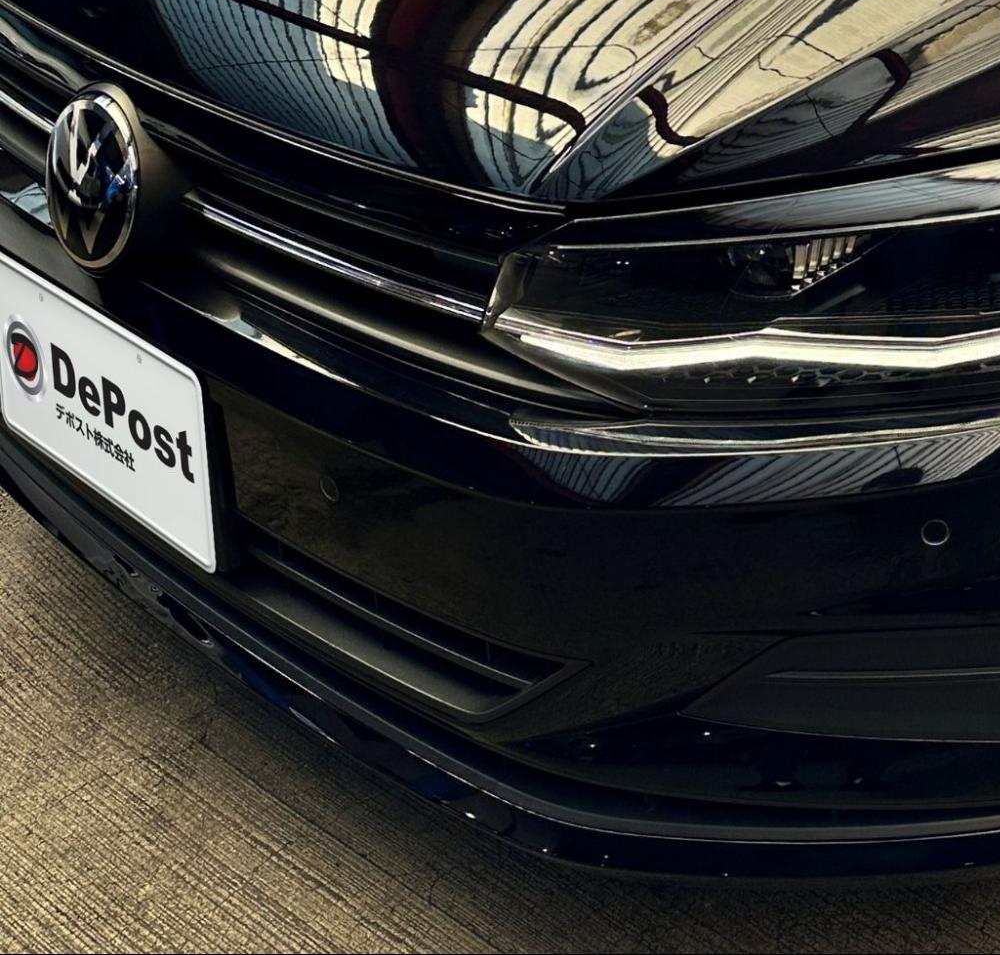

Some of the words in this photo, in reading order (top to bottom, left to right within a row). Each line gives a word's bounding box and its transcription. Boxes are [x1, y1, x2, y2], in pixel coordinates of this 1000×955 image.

[50, 342, 195, 484] DePost
[55, 402, 136, 473] デポスト株式会社
